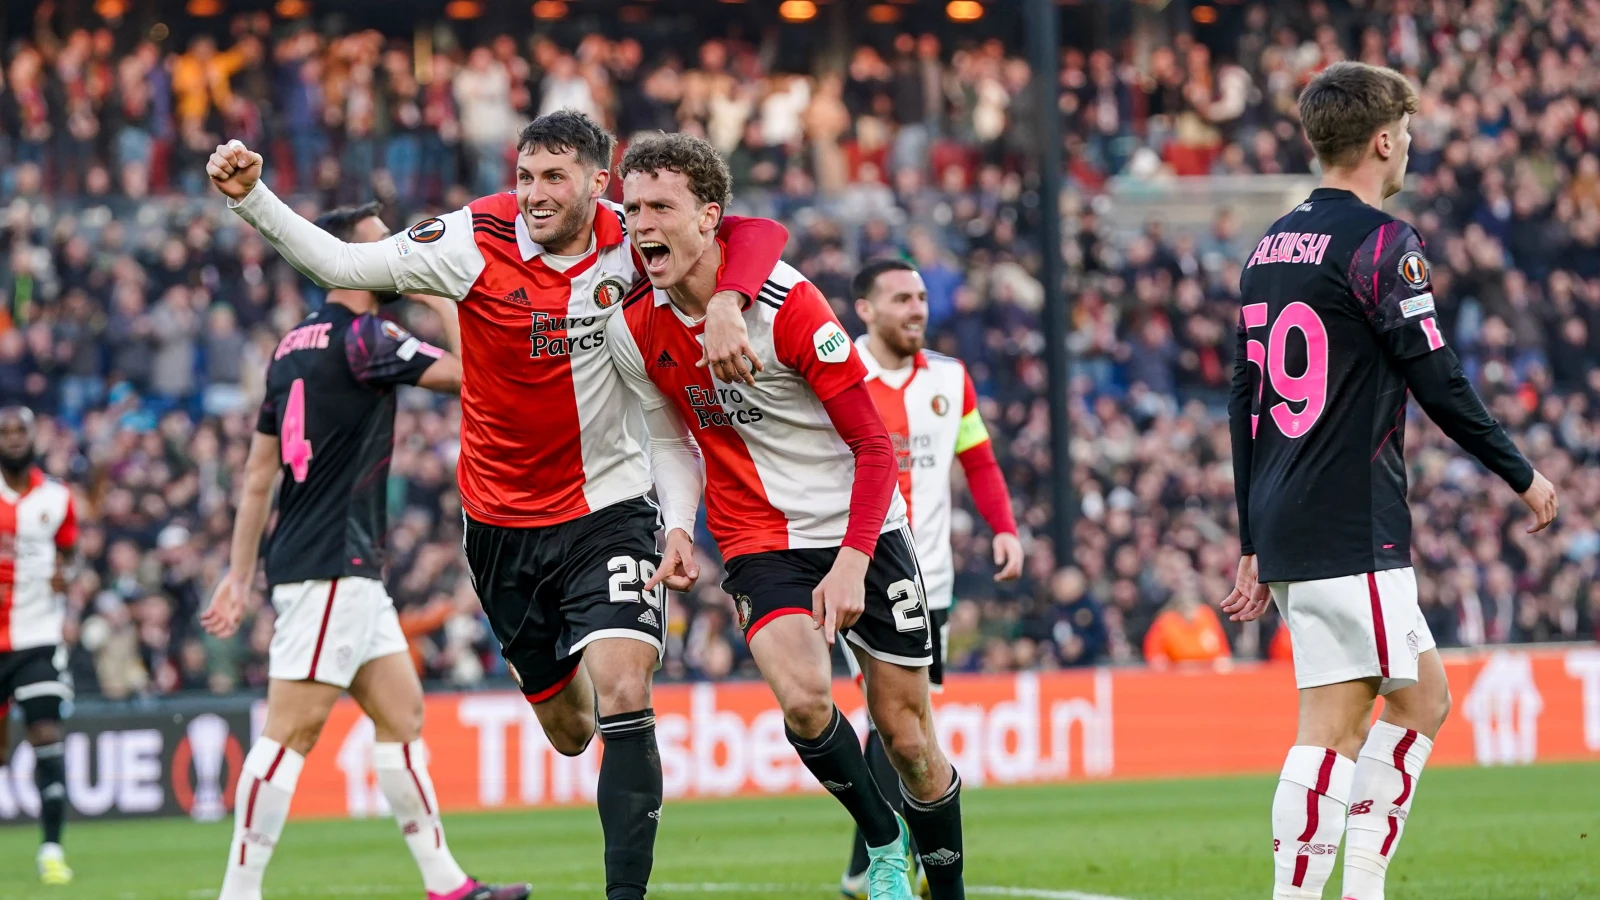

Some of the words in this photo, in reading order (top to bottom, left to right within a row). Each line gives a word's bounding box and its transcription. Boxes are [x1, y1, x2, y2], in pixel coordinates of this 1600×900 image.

[1247, 232, 1332, 269] ALEWSKI
[503, 295, 532, 306] adidas
[531, 312, 597, 334] Euro
[530, 329, 605, 358] Parcs
[817, 331, 846, 357] TOTO
[1242, 301, 1328, 439] 59
[685, 384, 744, 406] Euro
[693, 406, 764, 429] Parcs
[281, 378, 314, 483] 4
[898, 454, 936, 472] arcs
[637, 616, 660, 629] adidas
